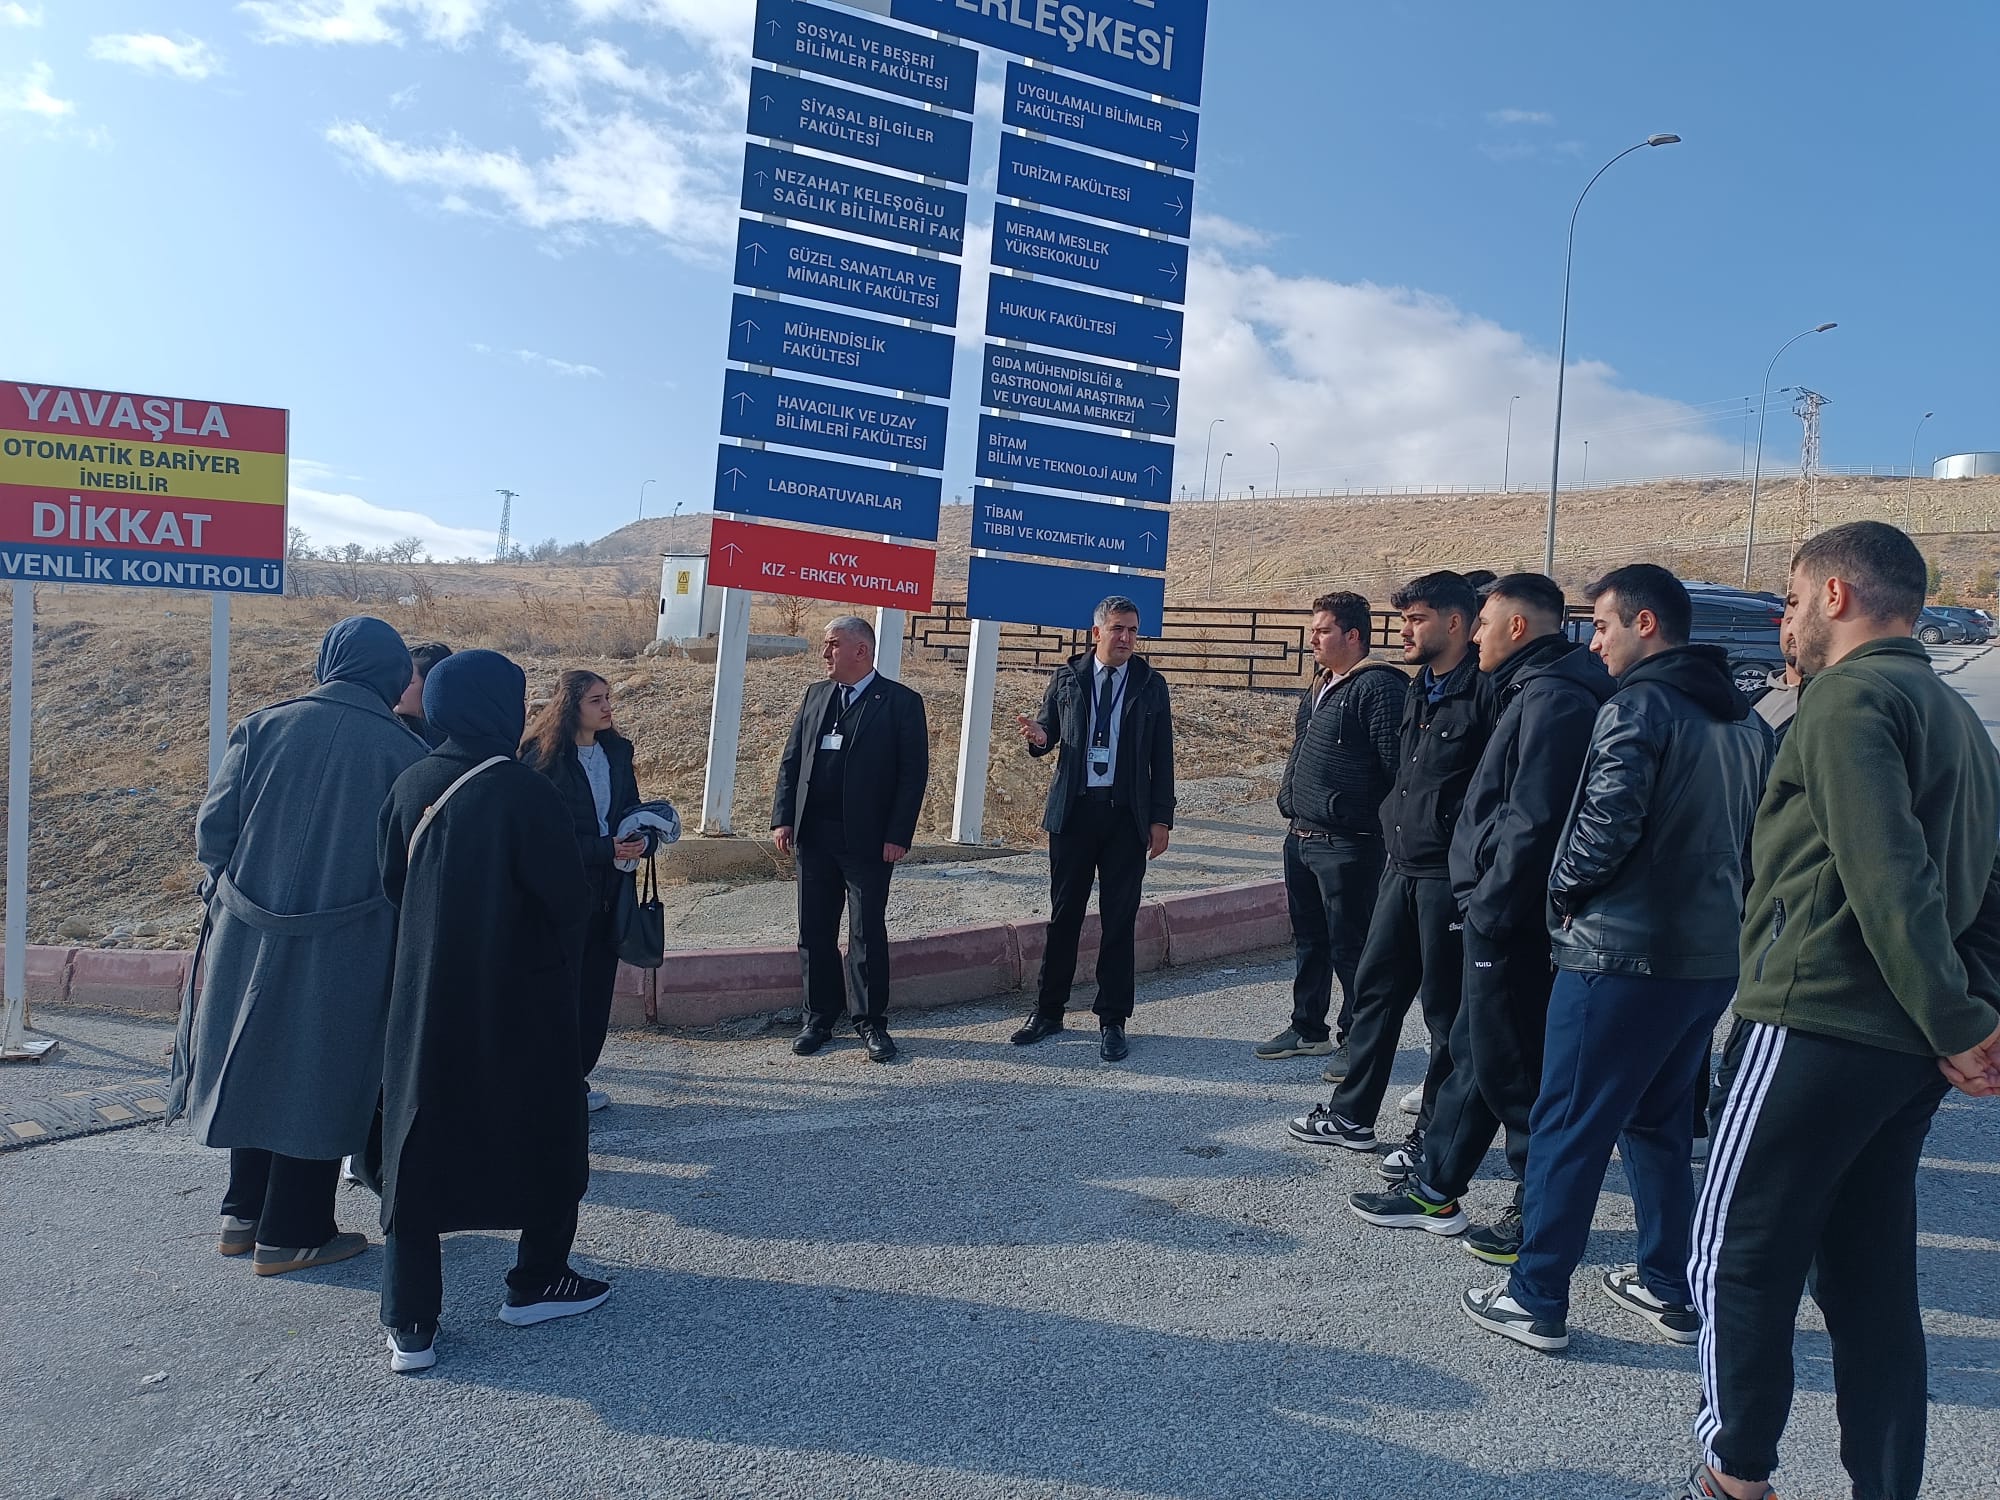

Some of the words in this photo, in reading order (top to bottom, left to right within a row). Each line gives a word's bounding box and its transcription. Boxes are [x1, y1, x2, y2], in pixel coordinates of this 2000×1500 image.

[797, 21, 856, 49] SOSYAL
[861, 38, 879, 54] VE
[883, 43, 935, 70] BEŞERİ
[796, 39, 867, 69] BİLİMLER
[871, 60, 948, 91] FAKÜLTESİ
[801, 97, 865, 126] SİYASAL
[869, 115, 934, 143] BİLGİLER
[1016, 101, 1085, 129] FAKÜLTESİ
[1018, 82, 1102, 117] UYGULAMALI
[1105, 105, 1162, 133] BİLİMLER
[799, 116, 880, 147] FAKÜLTESİ
[774, 167, 850, 196] NEZAHAT
[853, 185, 945, 218] KELEŞOĞLU
[1011, 161, 1061, 185] TURİZM
[1064, 174, 1131, 202] FAKÜLTESİ
[773, 187, 836, 214] SAĞLIK
[841, 201, 925, 233] BİLİMLERİ
[1005, 238, 1100, 271] YÜKSEKOKULU
[1006, 221, 1055, 244] MERAM
[1058, 231, 1109, 256] MESLEK
[789, 245, 836, 269] GÜZEL
[840, 258, 914, 285] SANATLAR
[918, 274, 937, 290] VE
[787, 265, 862, 293] MİMARLIK
[865, 281, 940, 309] FAKÜLTESİ
[1000, 301, 1047, 322] HUKUK
[1050, 312, 1117, 336] FAKÜLTESİ
[783, 341, 860, 367] FAKÜLTESİ
[784, 321, 886, 353] MÜHENDİSLİK
[992, 355, 1021, 371] GIDA
[1024, 360, 1112, 387] MÜHENDİSLİĞİ
[1115, 378, 1124, 389] &
[991, 372, 1073, 396] GASTRONOMİ
[1075, 388, 1145, 409] ARAŞTIRMA
[993, 389, 1009, 401] VE
[1011, 393, 1080, 415] UYGULAMA
[1084, 406, 1135, 424] MERKEZİ
[17, 386, 230, 441] YAVAŞLA
[777, 394, 855, 420] HAVACILIK
[858, 408, 876, 423] VE
[880, 412, 917, 430] UZAY
[776, 412, 850, 438] BİLİMLERİ
[852, 426, 927, 451] FAKÜLTESİ
[989, 432, 1027, 450] BİTAM
[4, 437, 132, 466] OTOMATİK
[139, 449, 241, 475] BARİYER
[988, 449, 1022, 467] BİLİM
[1025, 456, 1040, 469] VE
[1043, 458, 1108, 479] TEKNOLOJİ
[1110, 471, 1138, 484] AUM
[79, 467, 168, 493] İNEBİLİR
[768, 478, 902, 511] LABORATUVARLAR
[32, 495, 212, 548] DİKKAT
[984, 503, 1023, 521] TİBAM
[983, 522, 1015, 537] TIBBI
[1018, 526, 1033, 539] VE
[1036, 528, 1095, 547] KOZMETİK
[1098, 538, 1125, 551] AUM
[122, 559, 280, 590] KONTROLÜ
[829, 552, 858, 568] KYK
[761, 562, 785, 577] KIZ
[800, 567, 847, 586] ERKEK
[850, 574, 919, 595] YURTLARI
